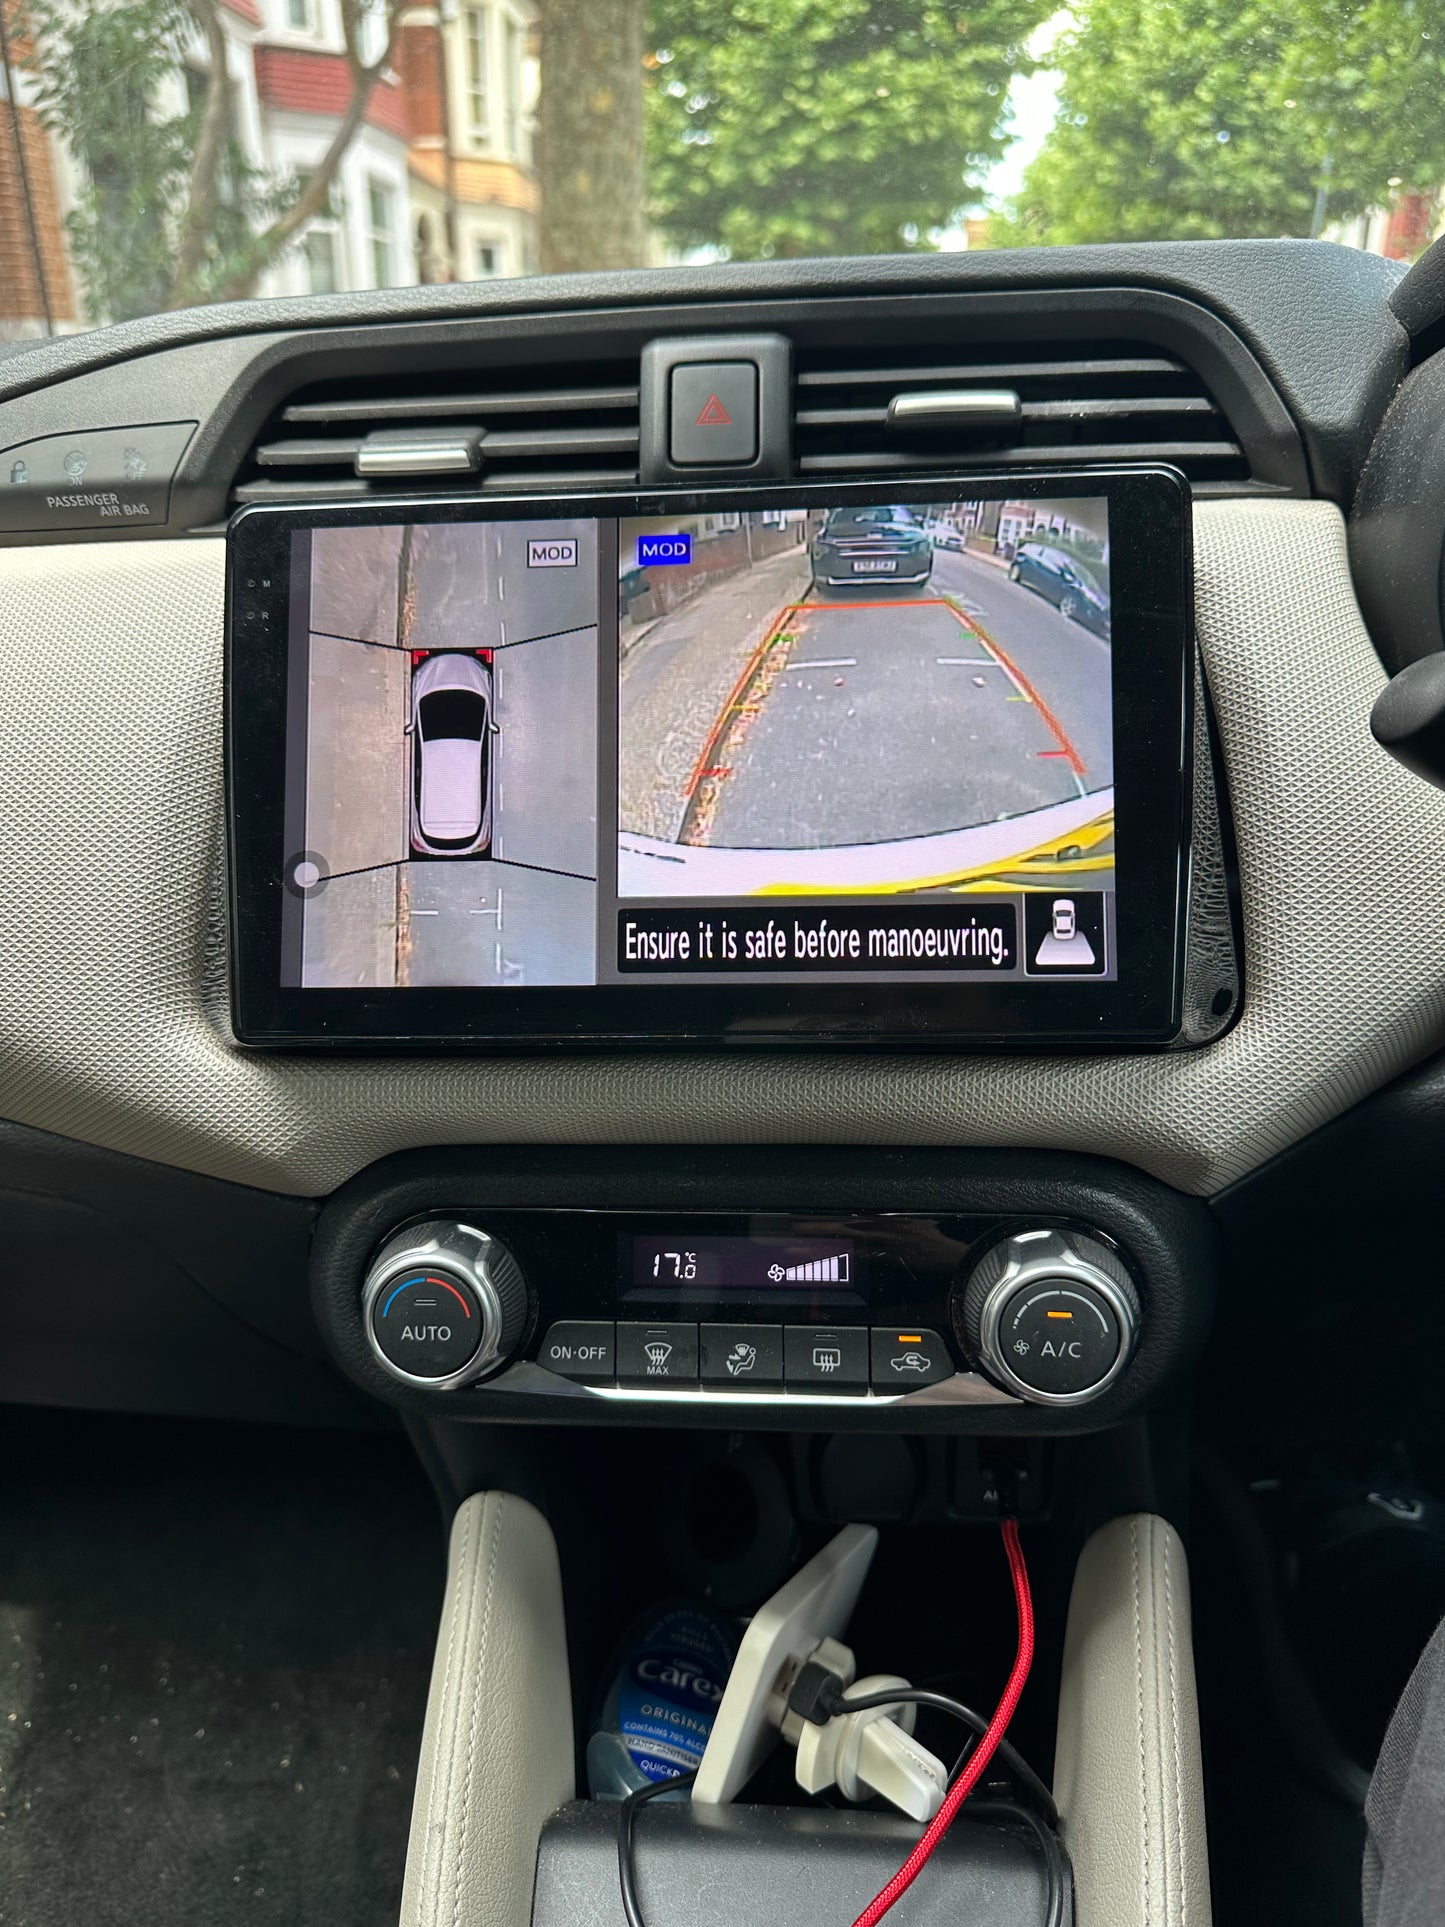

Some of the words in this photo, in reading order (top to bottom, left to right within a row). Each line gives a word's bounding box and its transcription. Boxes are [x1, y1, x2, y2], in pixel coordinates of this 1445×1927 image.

[46, 493, 120, 509] PASSENGER
[101, 505, 122, 517] AIR
[122, 503, 150, 516] BAG
[532, 546, 573, 561] MOD
[642, 542, 687, 557] MOD
[625, 922, 690, 960] Ensure
[699, 921, 714, 959] it
[722, 920, 738, 959] is
[745, 920, 787, 959] safe
[794, 919, 861, 958] before
[868, 917, 1009, 965] manoeuvring.
[401, 1325, 451, 1341] AUTO
[1040, 1340, 1082, 1358] A/C
[646, 1365, 669, 1376] MAX
[640, 1703, 711, 1736] ORIGINA
[623, 1720, 668, 1738] CONTAINS
[627, 1736, 655, 1750] HAND
